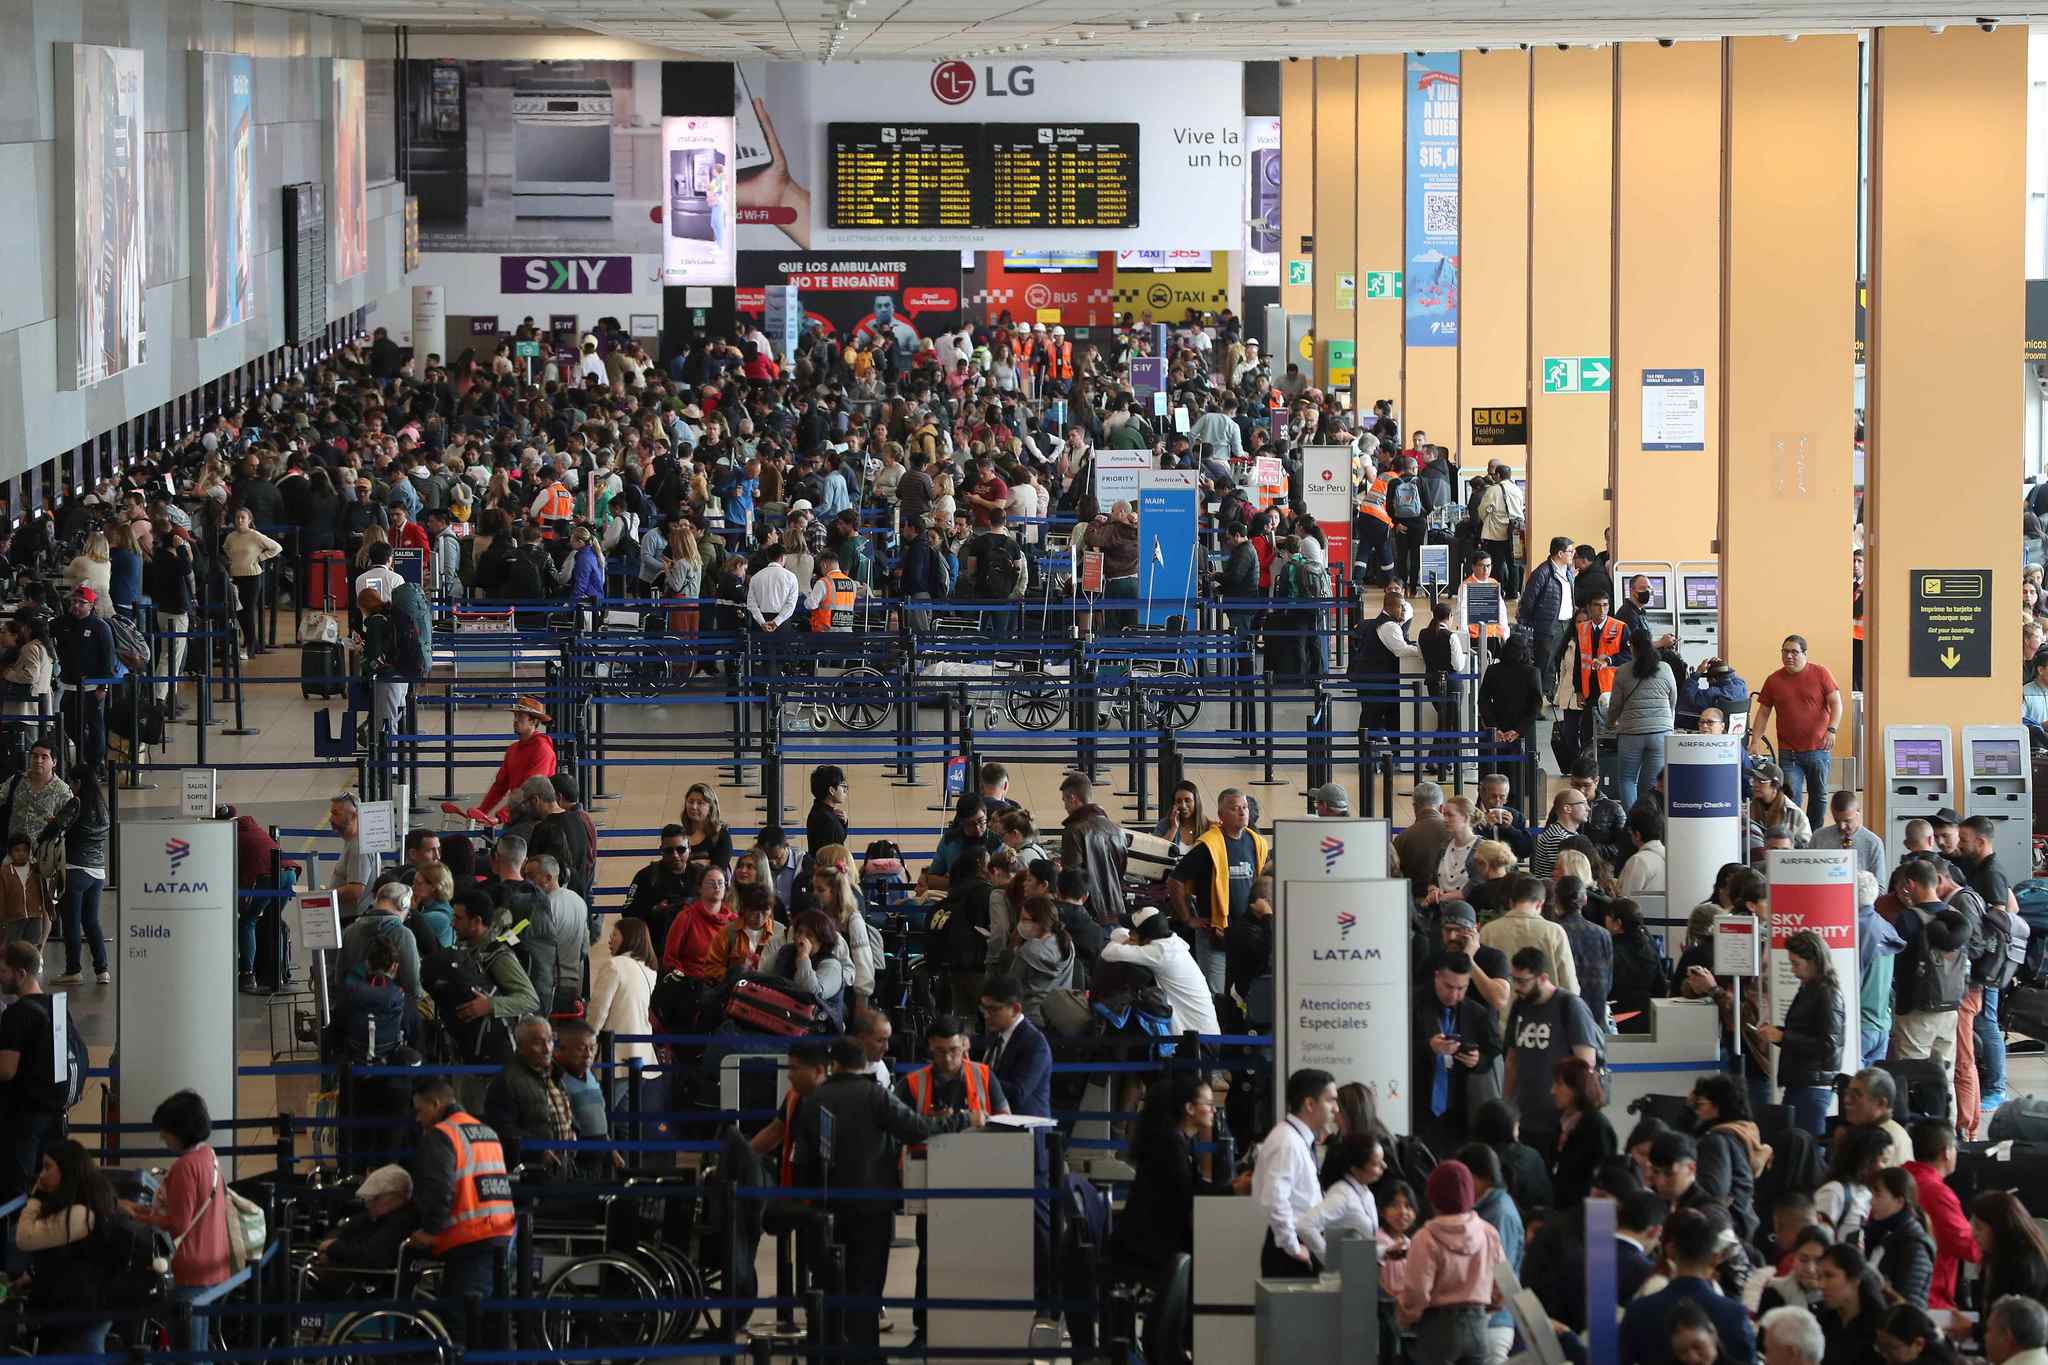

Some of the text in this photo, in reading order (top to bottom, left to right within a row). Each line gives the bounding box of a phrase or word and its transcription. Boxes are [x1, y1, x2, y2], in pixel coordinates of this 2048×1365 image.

[986, 65, 1035, 98] LG
[1173, 127, 1239, 144] Vive la
[1187, 151, 1242, 168] un ho
[1419, 147, 1458, 169] $15,0
[745, 210, 769, 220] Wi-Fi
[778, 262, 907, 273] QUE LOS AMBULANTES
[790, 273, 895, 288] NO TE ENGAÑEN
[1053, 292, 1078, 303] BUS
[1175, 291, 1205, 303] TAXI
[1474, 426, 1505, 435] Teléfono
[1307, 483, 1346, 493] Star Peru
[1144, 497, 1166, 505] MAIN
[1672, 802, 1702, 810] Economy
[1779, 857, 1840, 865] AIRFRANCE
[143, 882, 209, 894] LATAM
[1771, 913, 1806, 926] SKY
[129, 924, 170, 938] Salida
[129, 947, 147, 959] Exit
[1313, 949, 1381, 961] LATAM
[1300, 999, 1372, 1011] Atenciones
[1300, 1016, 1368, 1032] Especiales
[1301, 1040, 1335, 1053] Special
[1301, 1054, 1353, 1065] Assistance
